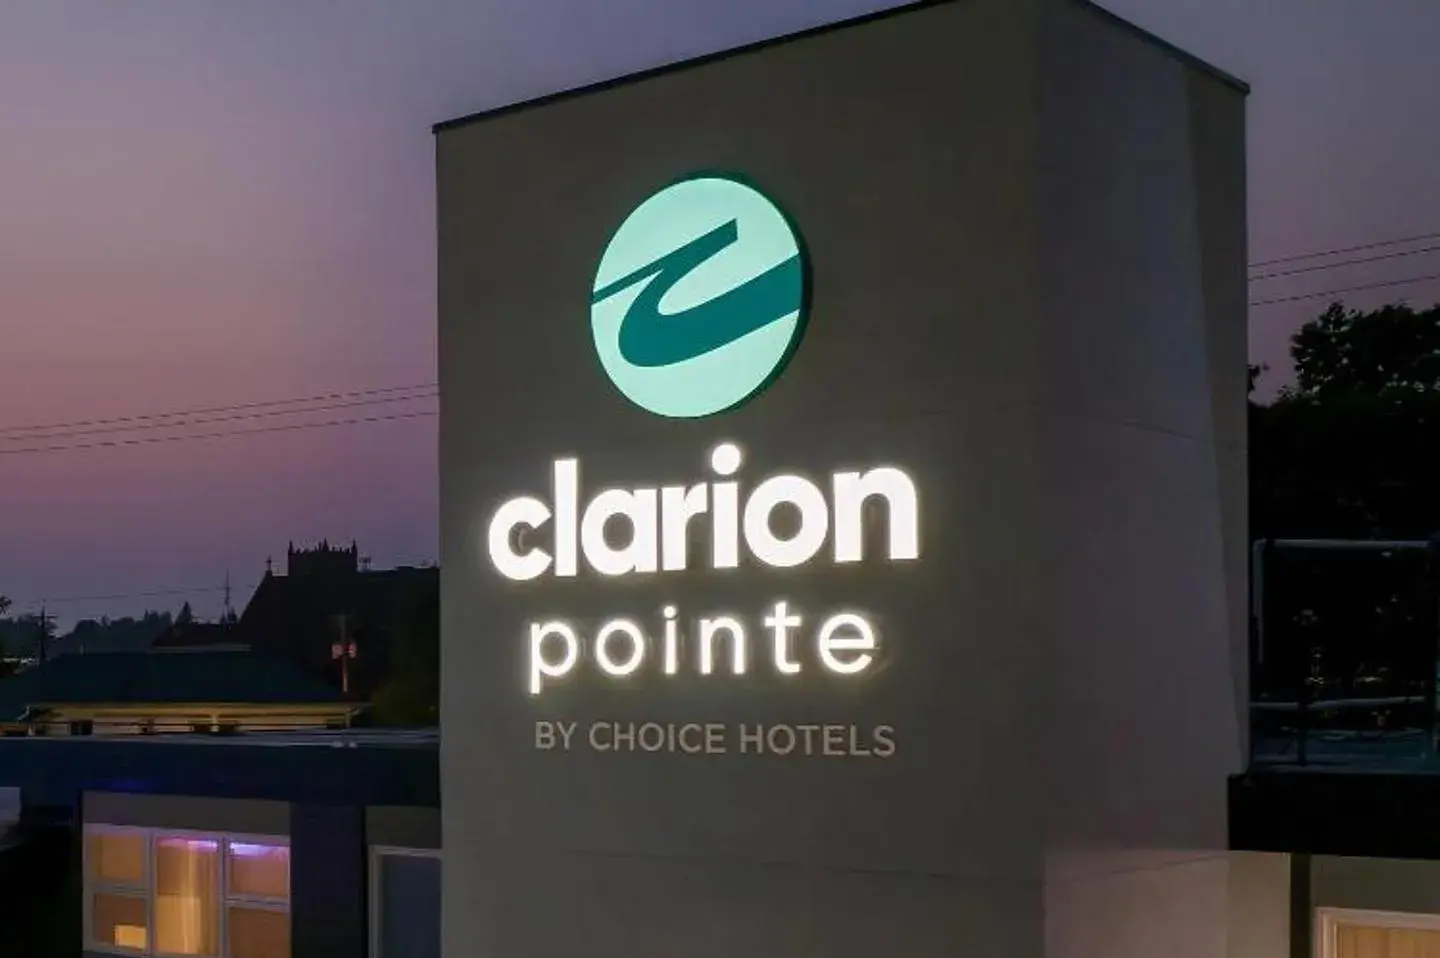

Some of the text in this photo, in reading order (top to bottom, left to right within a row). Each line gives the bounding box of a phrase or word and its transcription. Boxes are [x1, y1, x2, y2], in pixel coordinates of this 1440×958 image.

[488, 443, 918, 580] clarion
[528, 601, 878, 694] pointe
[534, 721, 896, 758] BY CHOICE HOTELS
